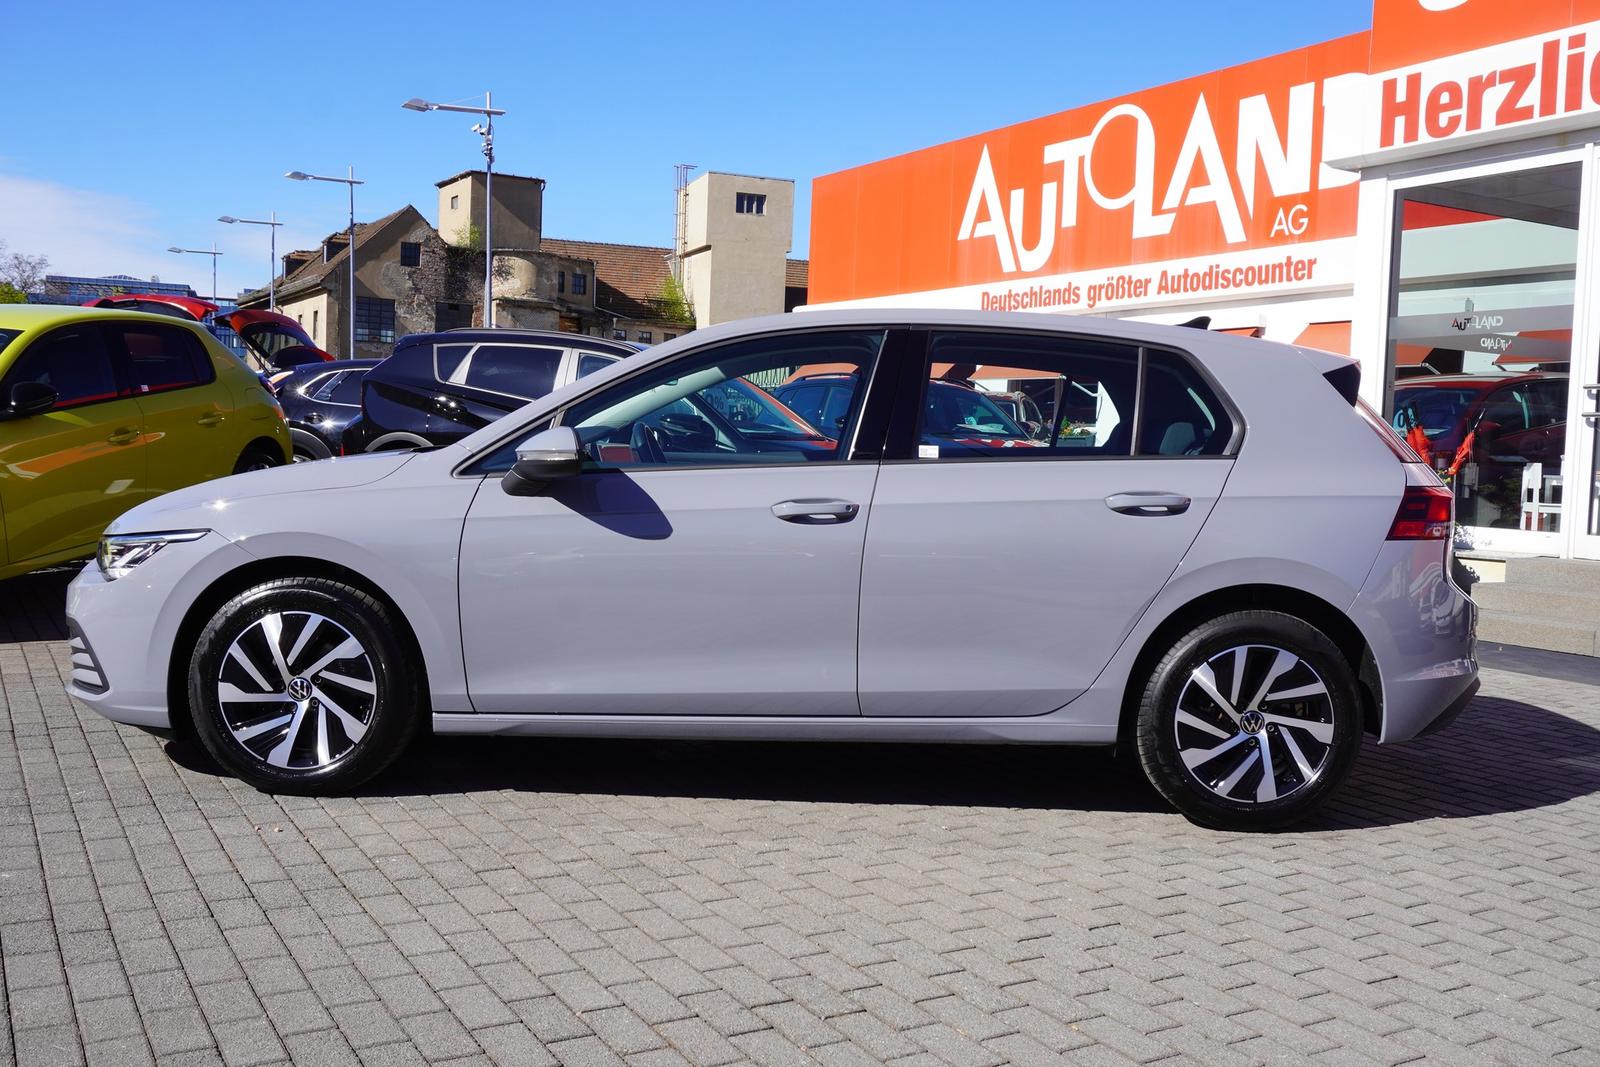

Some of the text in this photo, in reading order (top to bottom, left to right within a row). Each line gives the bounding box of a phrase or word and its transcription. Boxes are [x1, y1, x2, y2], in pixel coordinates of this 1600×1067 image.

[1270, 204, 1309, 238] AG
[981, 255, 1317, 312] Deutschlands größter Autodiscounter
